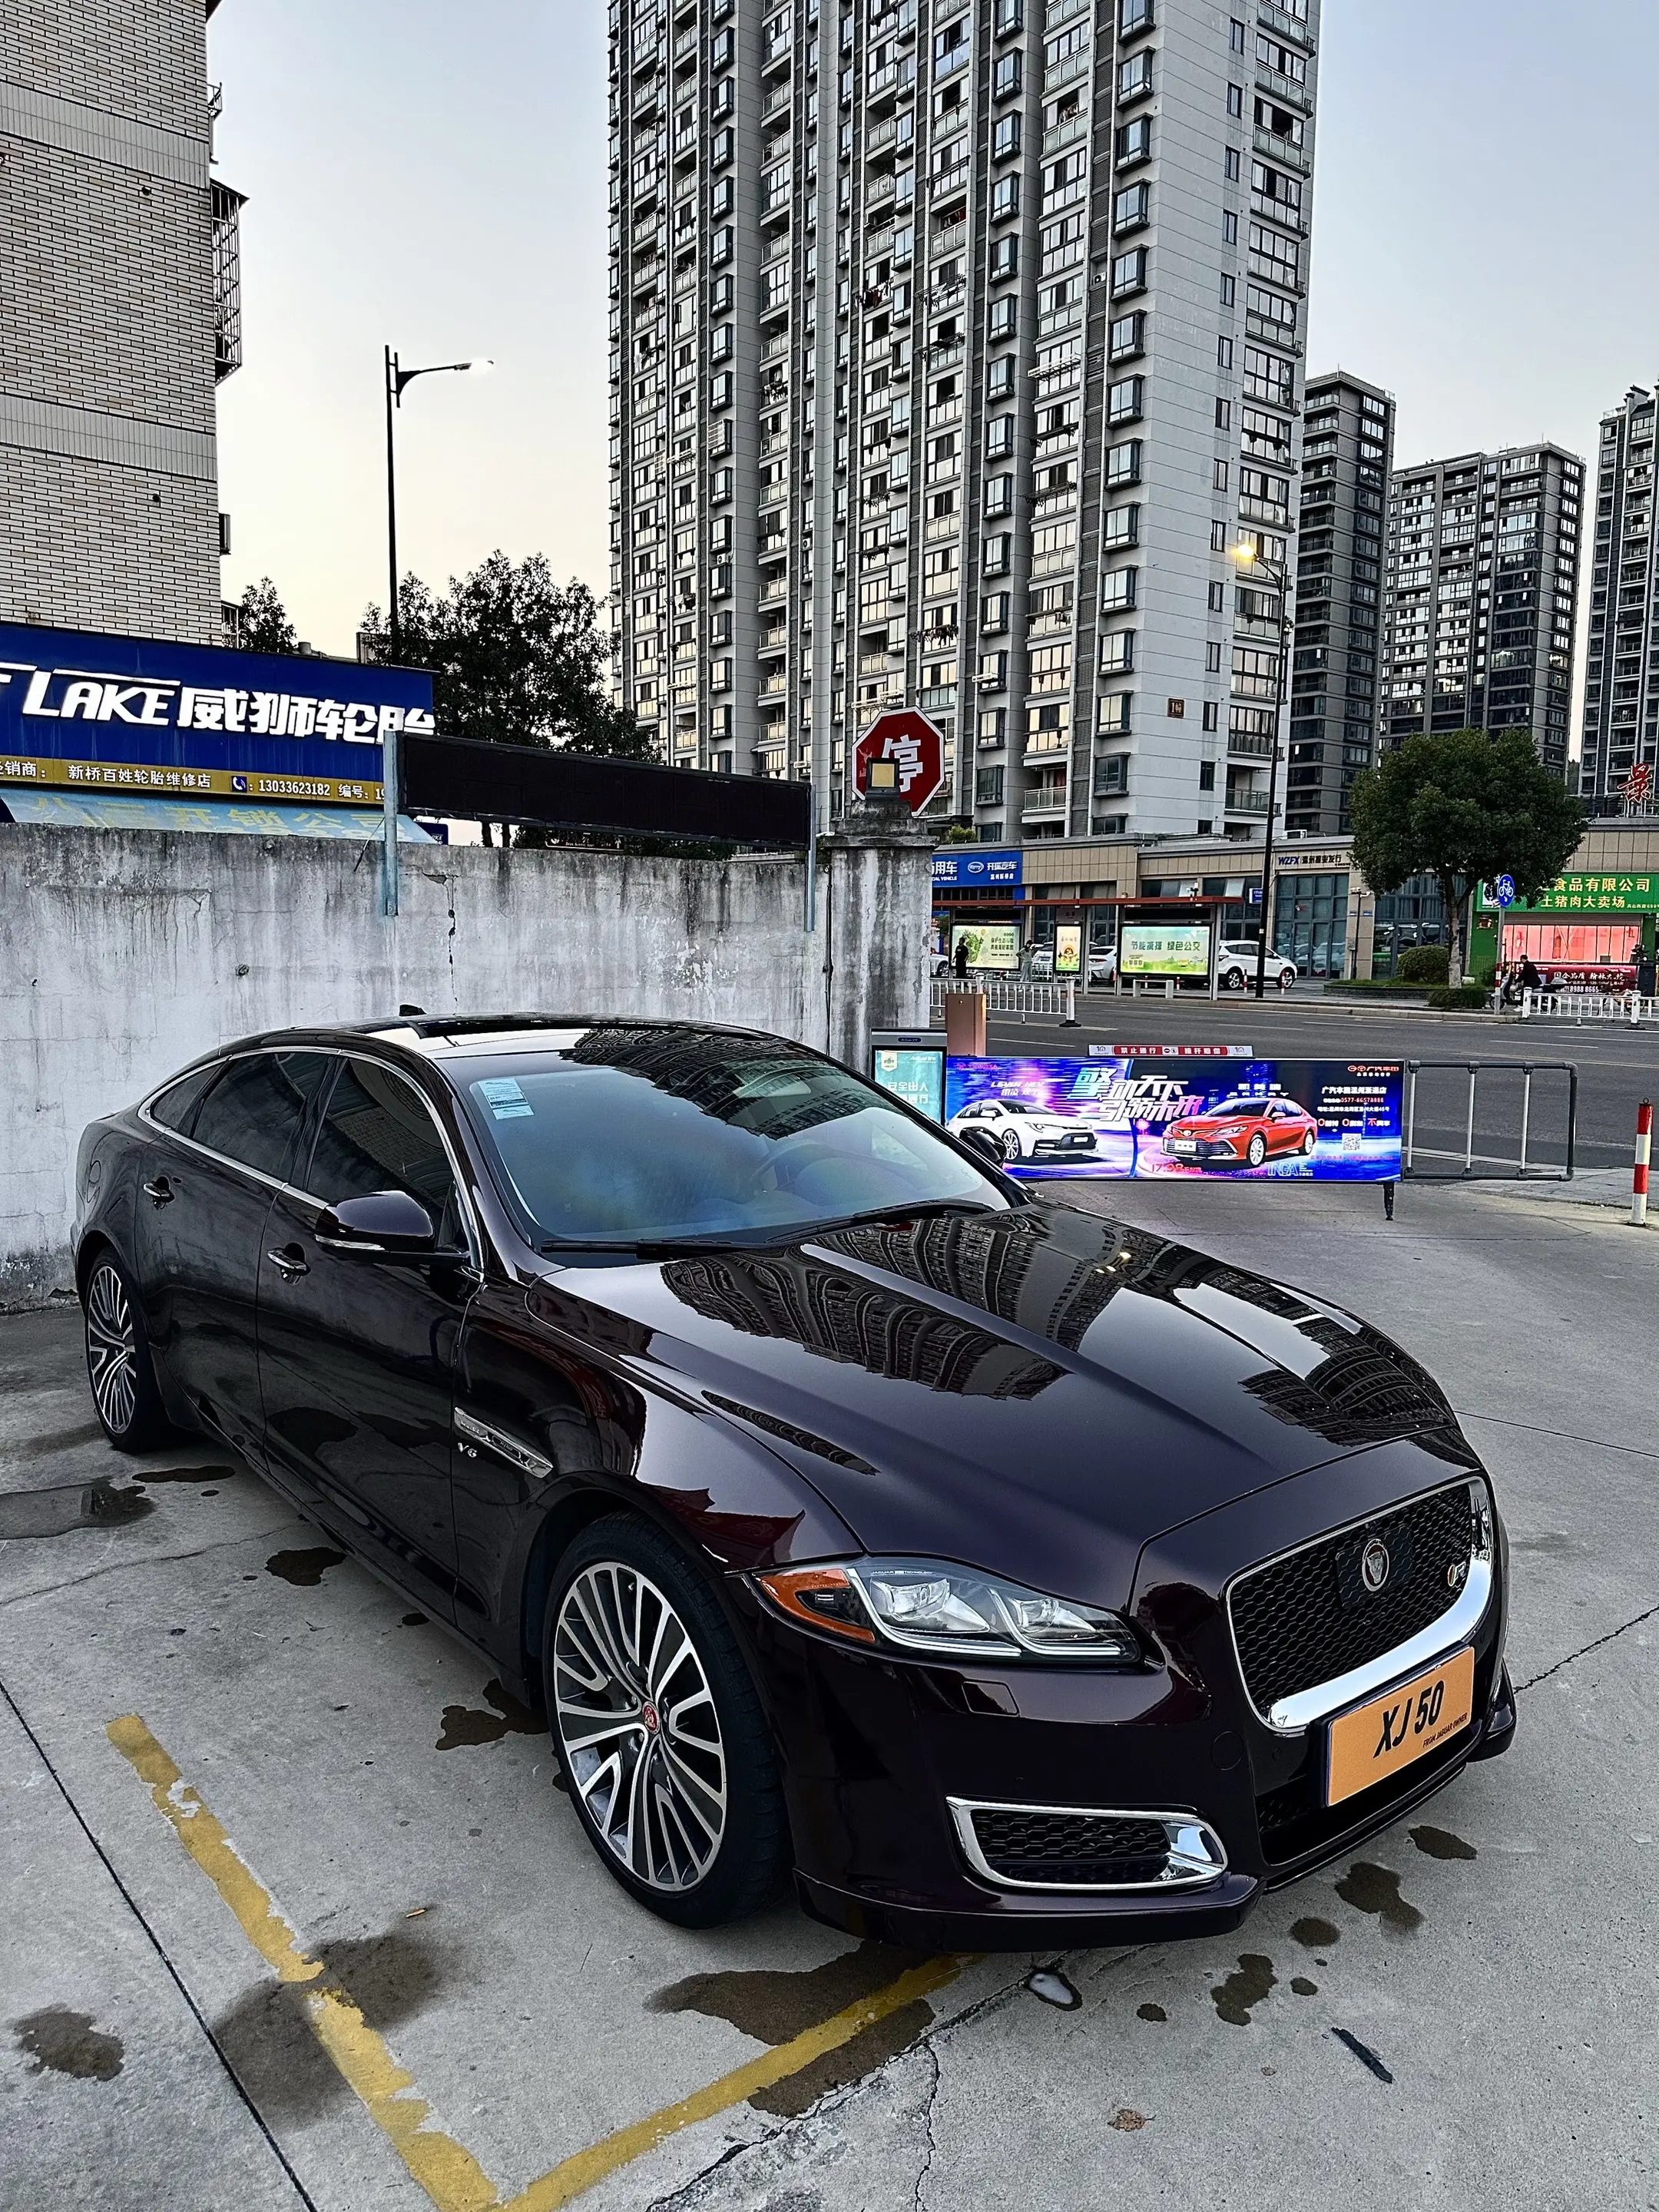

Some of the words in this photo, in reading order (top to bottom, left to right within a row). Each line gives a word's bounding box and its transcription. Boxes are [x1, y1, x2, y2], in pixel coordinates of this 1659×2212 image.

[0, 662, 180, 725] LAKE
[177, 687, 435, 744] 威狮轮胎
[68, 764, 211, 788] 新桥百姓轮胎维修店
[1278, 856, 1300, 866] WZFX
[1541, 877, 1651, 892] 食品有限公司
[1541, 896, 1625, 909] 土猪肉大卖场
[1167, 941, 1201, 951] 绿色公交
[458, 1442, 478, 1458] V6
[1373, 1694, 1413, 1759] XJ
[1414, 1680, 1445, 1734] 50
[1422, 1732, 1437, 1748] FROM
[1435, 1721, 1453, 1740] JAGUAR
